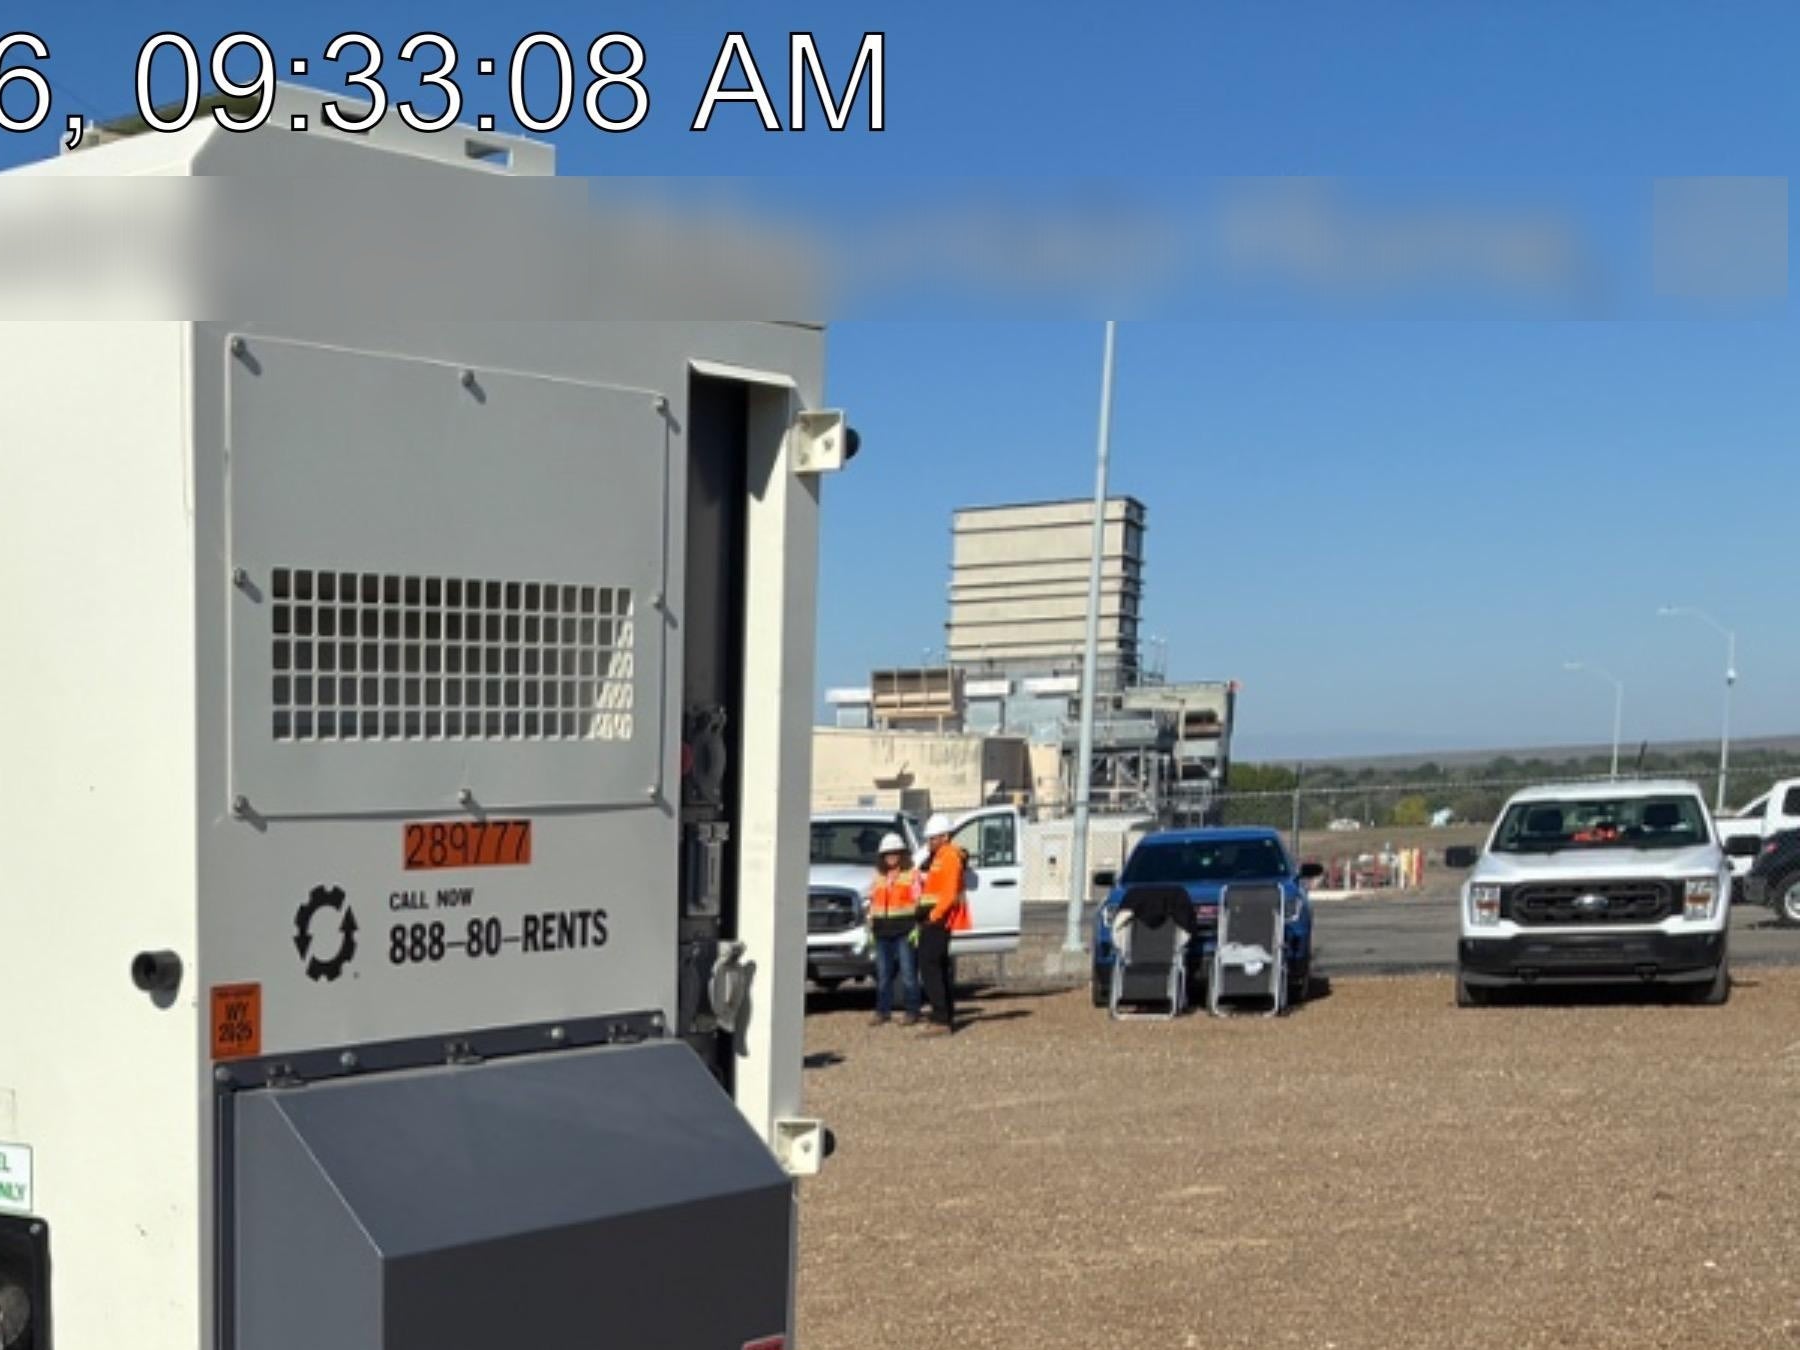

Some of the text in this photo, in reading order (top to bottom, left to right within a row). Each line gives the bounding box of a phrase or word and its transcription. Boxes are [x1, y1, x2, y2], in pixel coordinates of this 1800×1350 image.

[406, 820, 532, 869] 289777
[389, 886, 474, 911] CALL NOW
